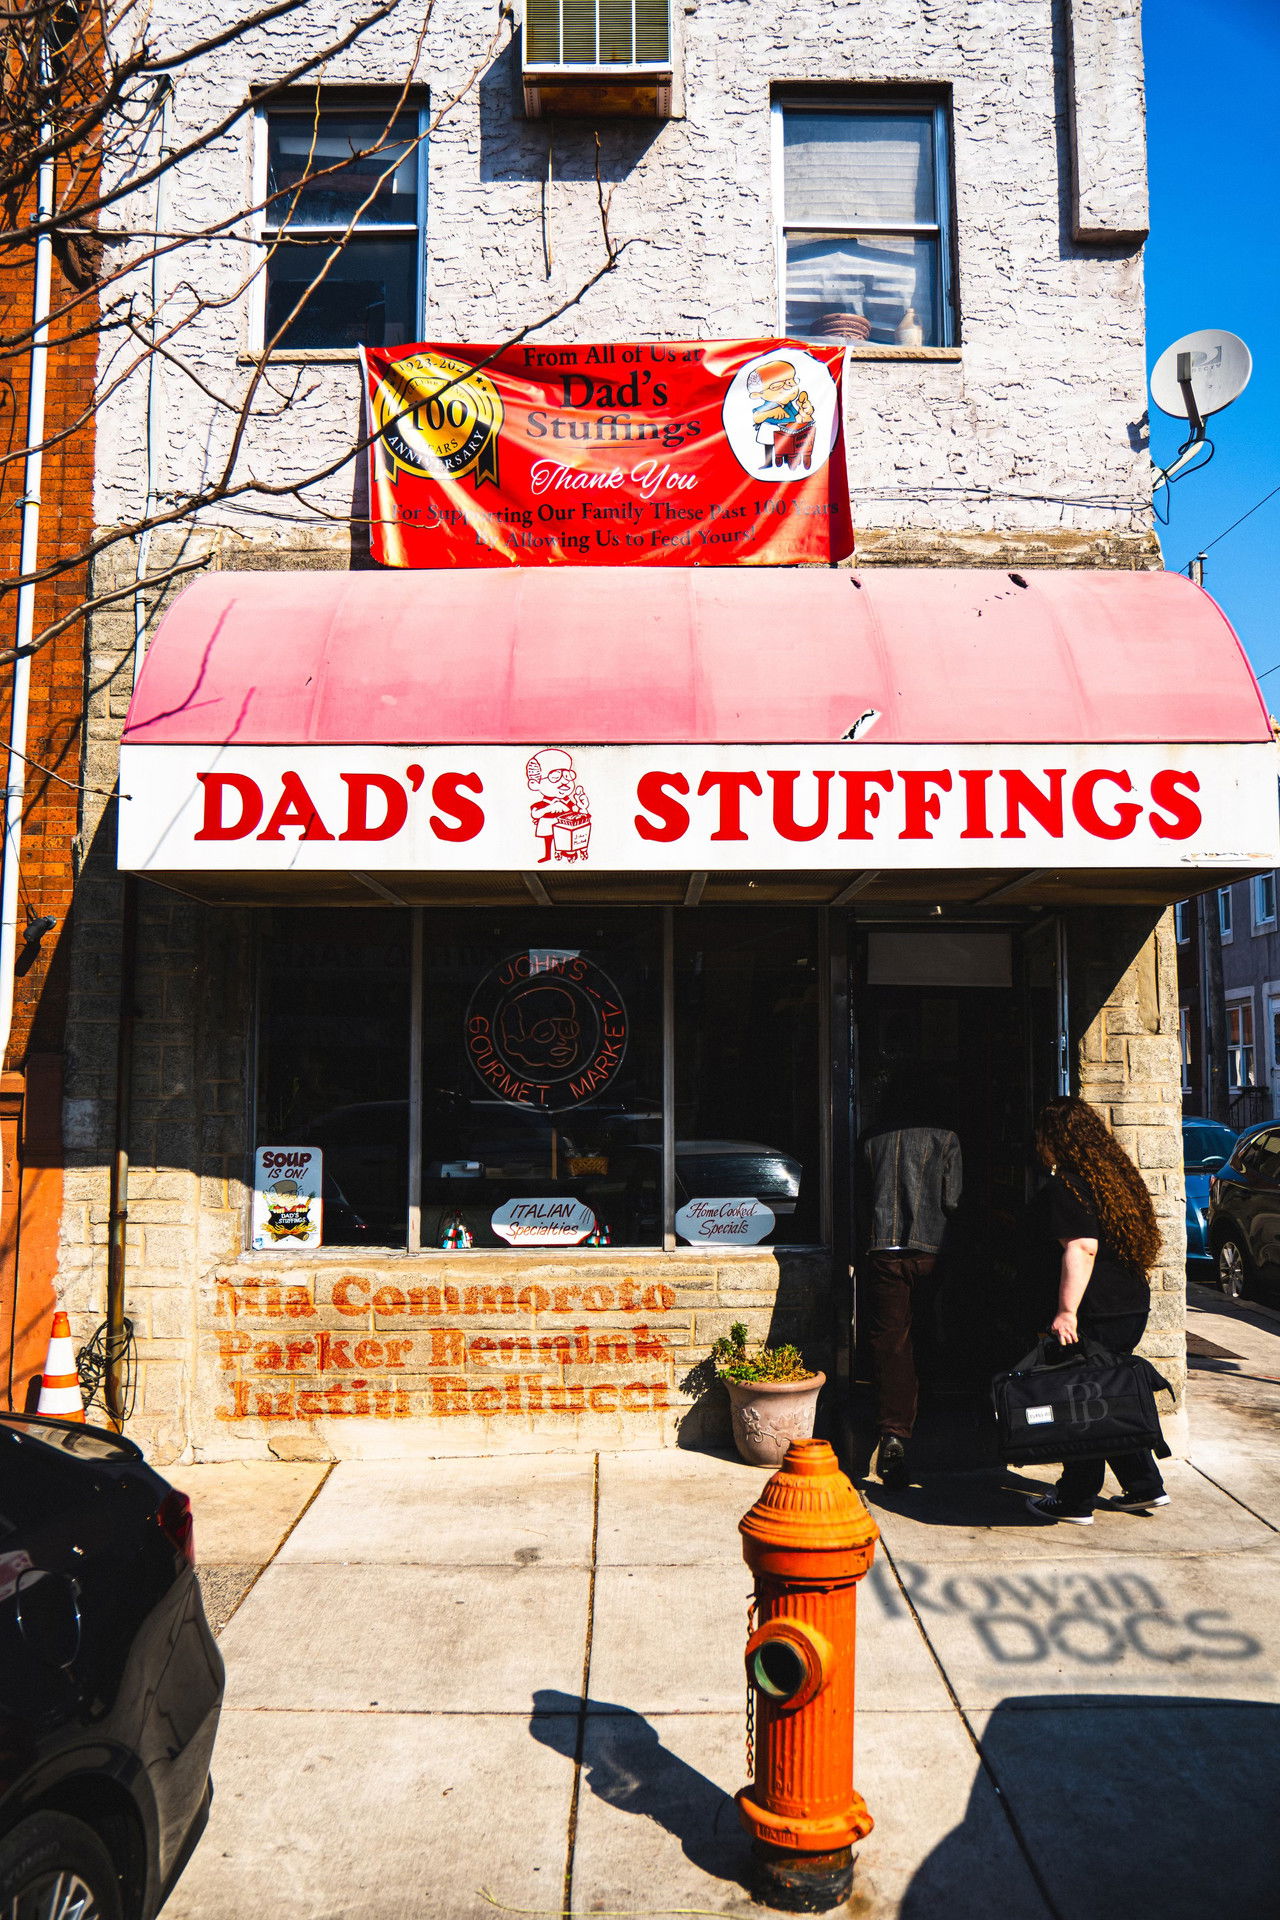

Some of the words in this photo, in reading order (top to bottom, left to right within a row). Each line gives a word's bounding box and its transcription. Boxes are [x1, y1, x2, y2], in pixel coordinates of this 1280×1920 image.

[398, 358, 465, 373] 1923-202
[523, 346, 578, 366] From
[584, 345, 616, 364] All
[621, 348, 643, 363] of
[650, 344, 676, 362] Us
[682, 348, 701, 362] at
[559, 369, 668, 409] Dad's
[411, 399, 469, 431] 100
[526, 411, 701, 448] Stuffings
[530, 459, 625, 495] Thank
[631, 459, 699, 499] You
[427, 503, 534, 529] Supprting
[537, 504, 576, 522] Our
[582, 502, 645, 525] Family
[650, 501, 704, 521] These
[710, 503, 747, 520] Past
[754, 500, 787, 516] 100
[791, 499, 839, 516] Years
[505, 531, 590, 554] Allowing
[595, 530, 619, 547] Us
[625, 534, 644, 547] to
[650, 530, 691, 547] Feed
[697, 526, 757, 548] Yours!
[194, 764, 485, 842] DAD'S
[634, 769, 1202, 843] STUFFINGS
[468, 1015, 551, 1104] GOURMET
[569, 1008, 624, 1100] MARKET
[262, 1151, 312, 1168] SOUP
[268, 1168, 282, 1179] IS
[284, 1167, 309, 1180] ON!
[509, 1203, 577, 1219] ITALIAN
[505, 1221, 579, 1240] Specialties
[698, 1219, 749, 1239] Specials
[214, 1276, 319, 1319] Mia
[214, 1330, 414, 1370] Parker
[867, 1559, 1170, 1621] Rowan
[970, 1609, 1264, 1667] DOCS
